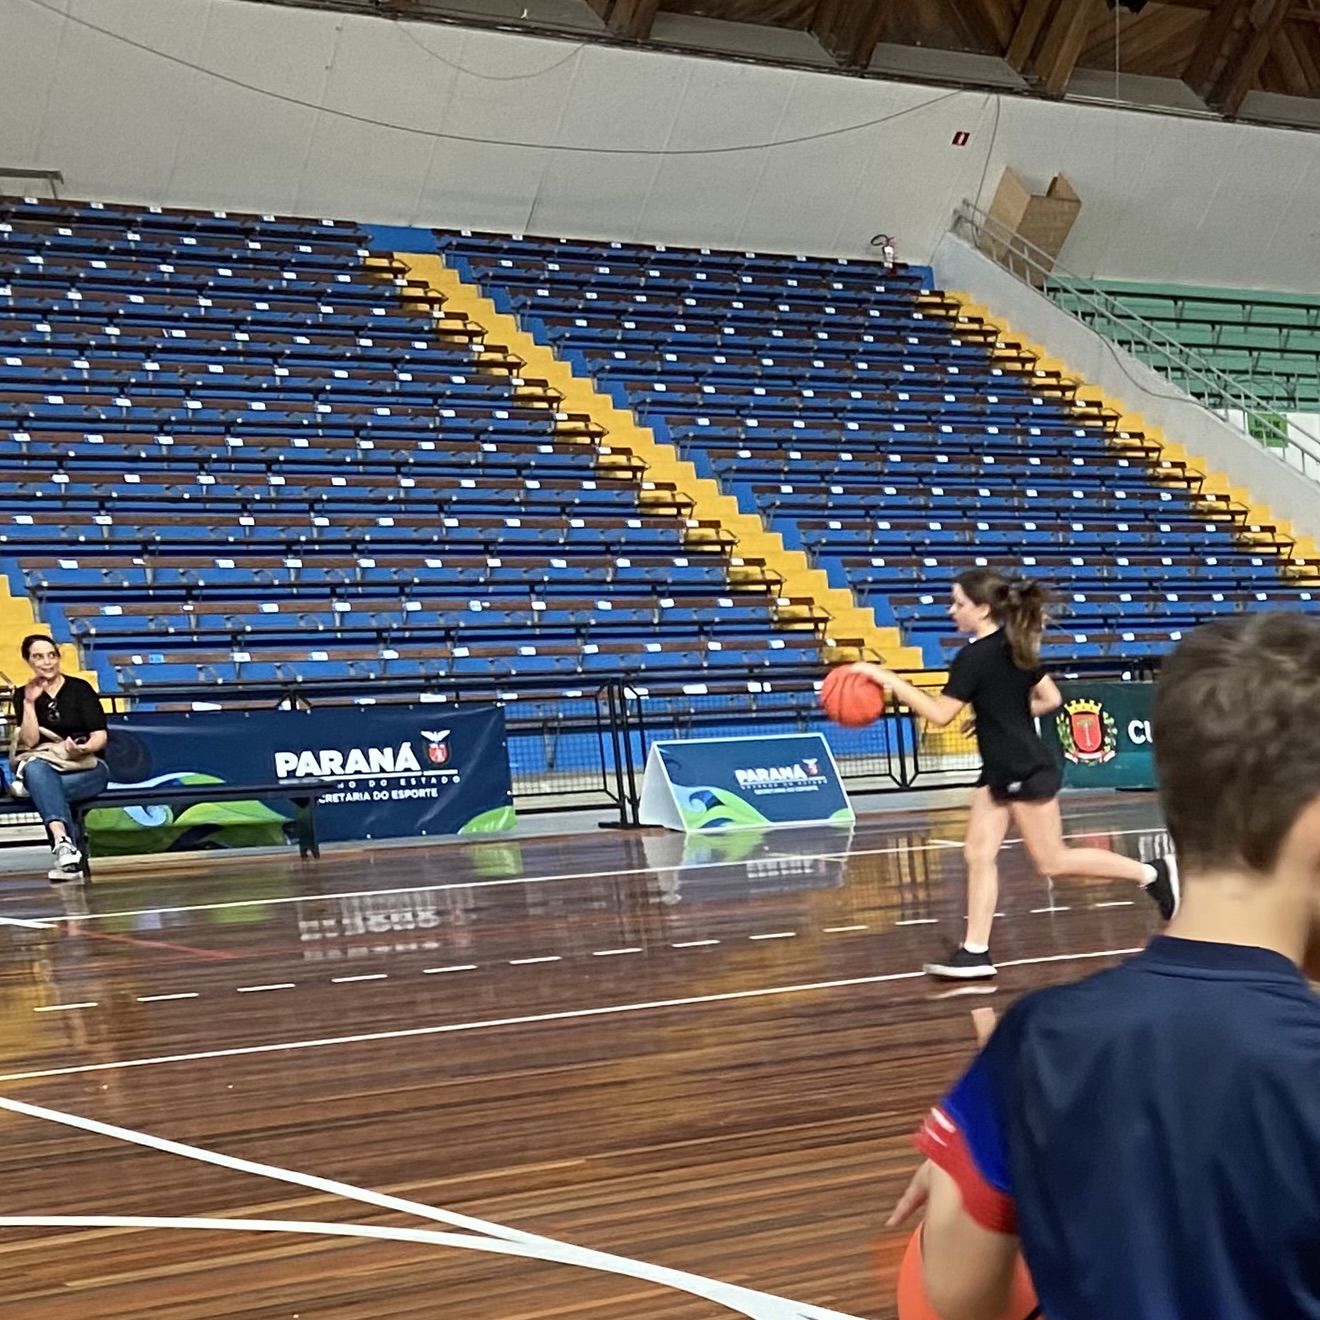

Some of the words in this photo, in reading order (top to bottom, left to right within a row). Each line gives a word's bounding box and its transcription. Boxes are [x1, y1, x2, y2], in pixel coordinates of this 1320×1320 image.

[274, 742, 421, 777] PARANÁ
[369, 778, 388, 788] DO
[400, 776, 461, 786] ESTADO
[373, 790, 389, 800] DO
[391, 788, 439, 799] ESPORTE
